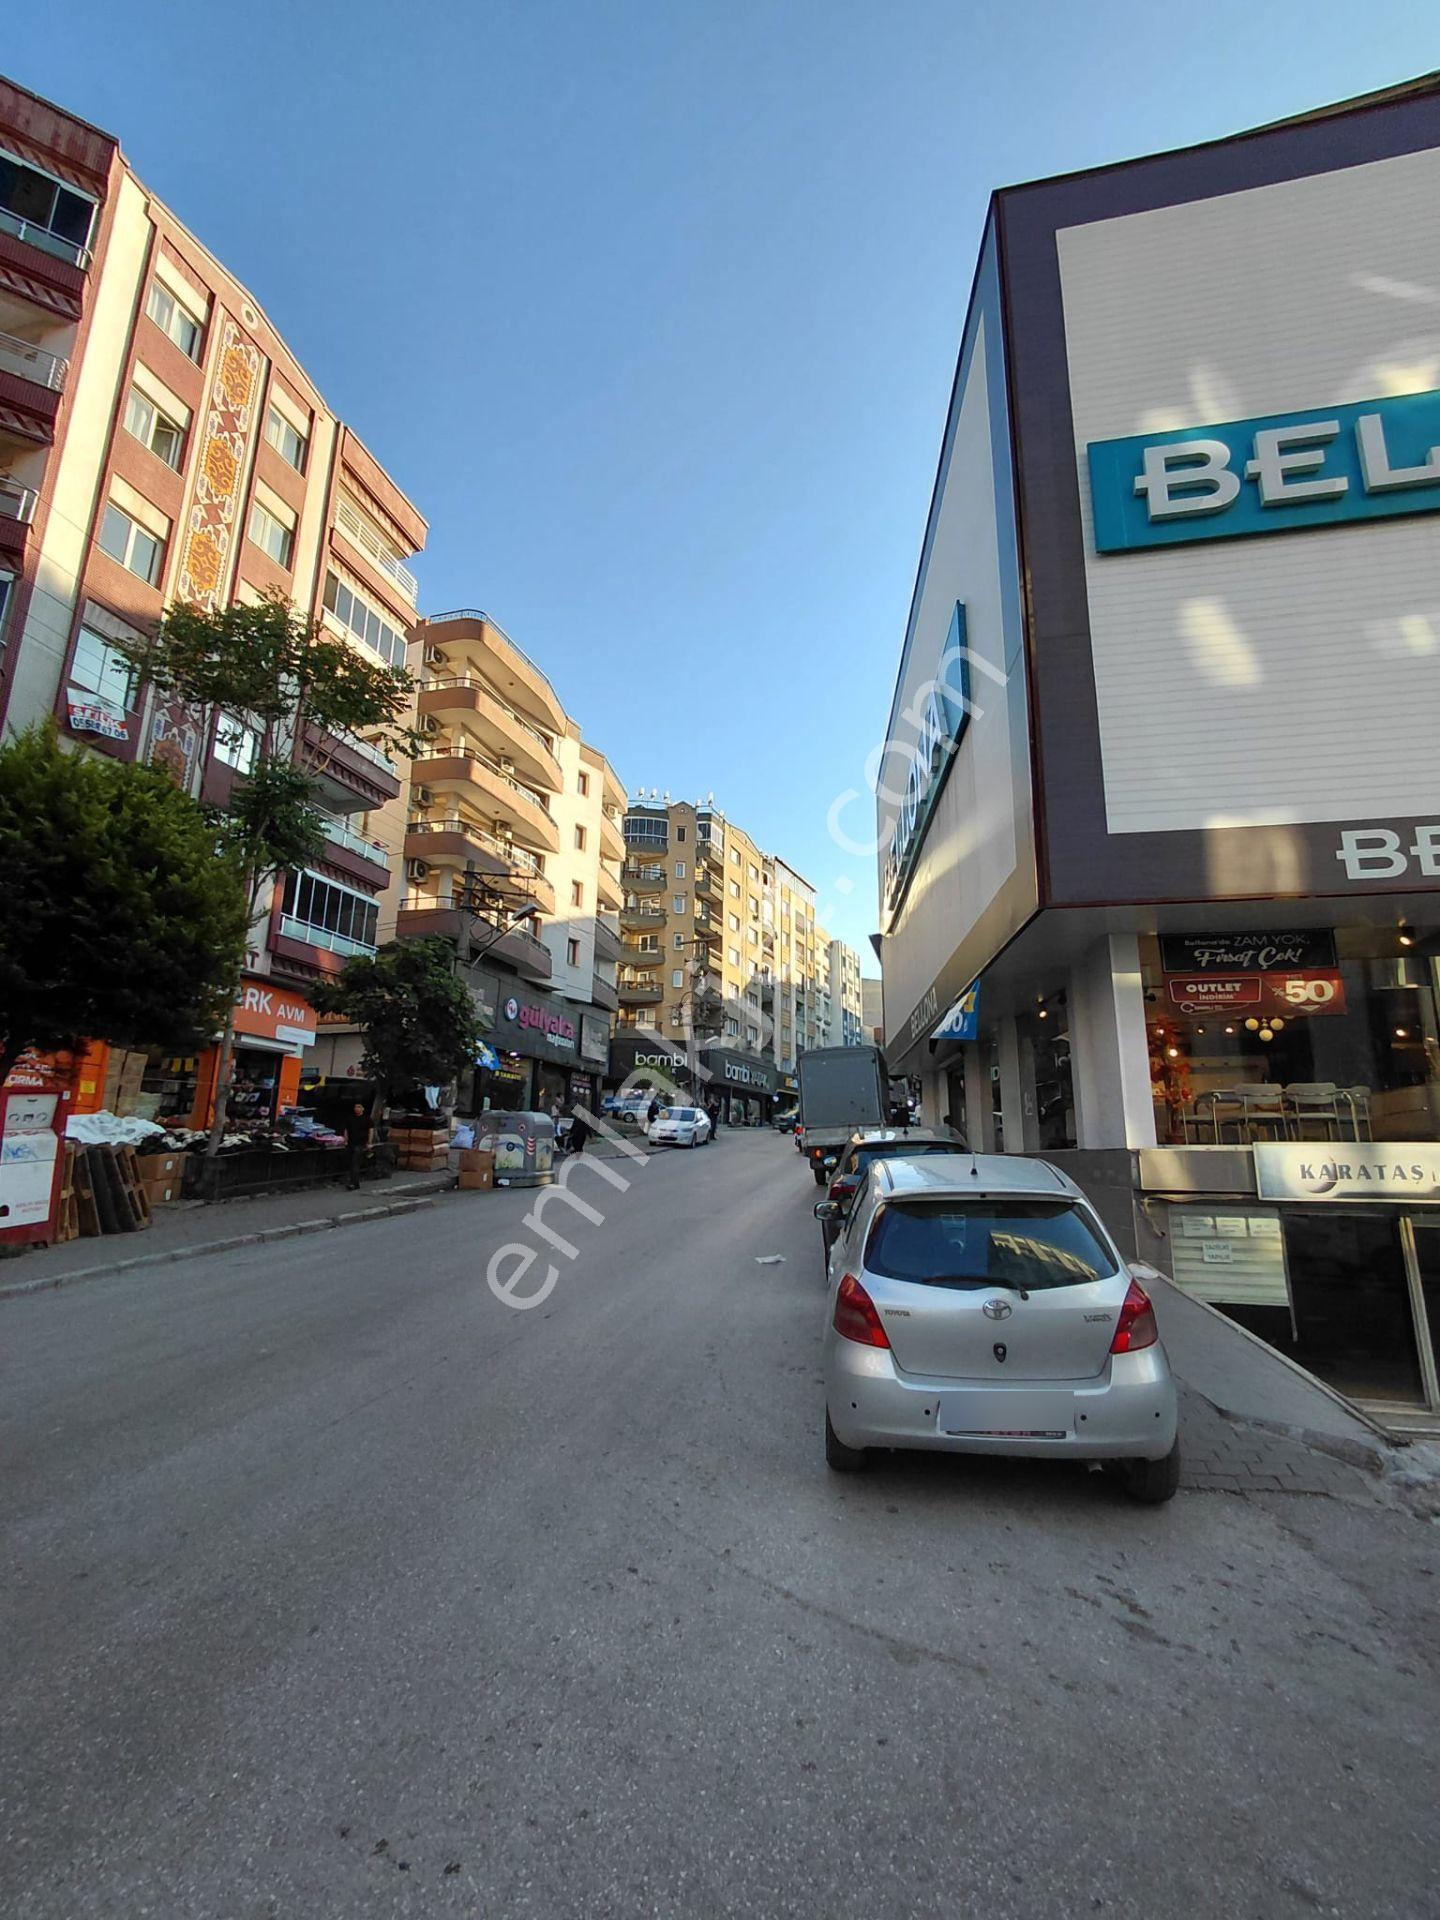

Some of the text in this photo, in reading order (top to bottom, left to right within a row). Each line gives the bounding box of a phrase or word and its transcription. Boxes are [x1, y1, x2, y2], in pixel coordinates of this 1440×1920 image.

[1133, 410, 1440, 523] BEL
[1233, 934, 1268, 947] ZAM
[1186, 982, 1242, 993] OUTLET
[276, 1003, 305, 1023] AVM
[910, 986, 939, 1040] BELLONA
[635, 1051, 688, 1067] bambi
[724, 1059, 750, 1084] bambi
[1299, 1163, 1425, 1185] KARATAŞ
[884, 1308, 911, 1317] TOYOTA
